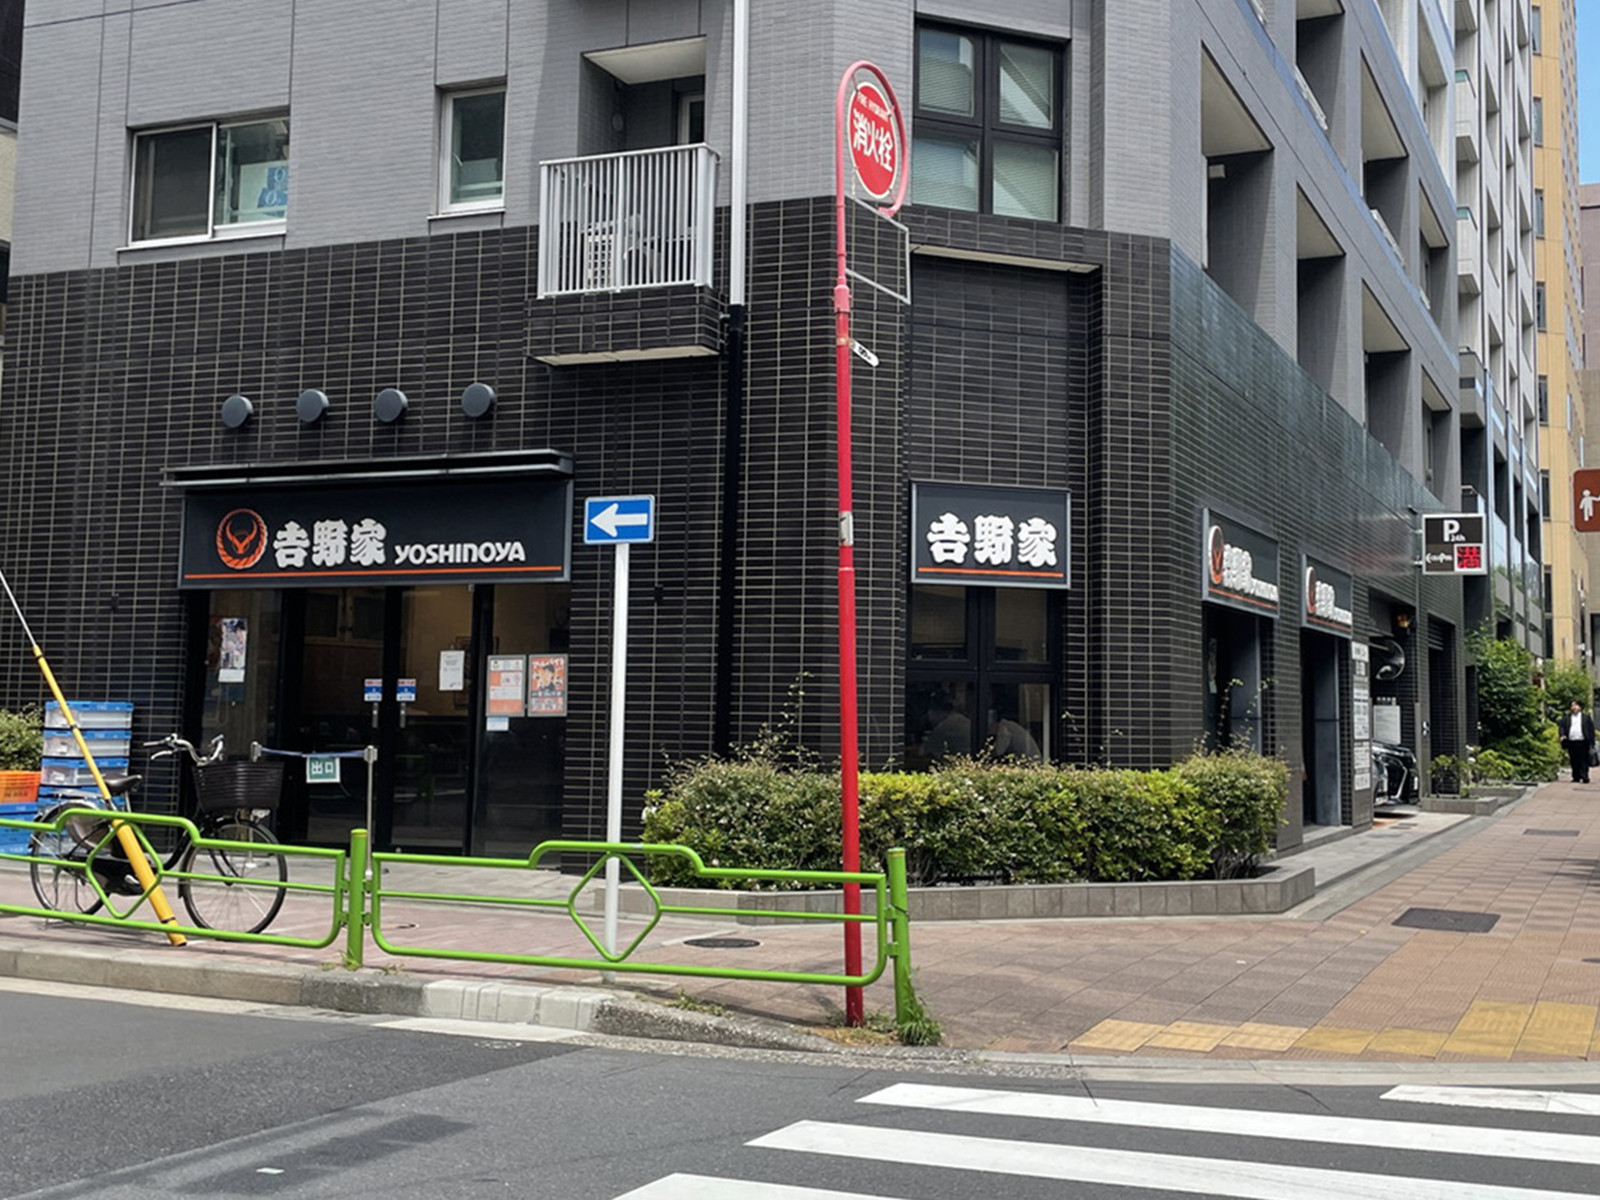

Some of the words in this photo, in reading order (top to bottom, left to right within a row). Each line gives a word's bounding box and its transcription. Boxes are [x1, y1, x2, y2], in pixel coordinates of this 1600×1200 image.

[853, 108, 893, 172] 消火栓
[273, 518, 387, 568] 吉野家
[394, 541, 526, 565] YOSHINOYA
[926, 512, 1058, 567] 吉野家
[1443, 519, 1460, 542] P
[311, 761, 334, 775] 出口
